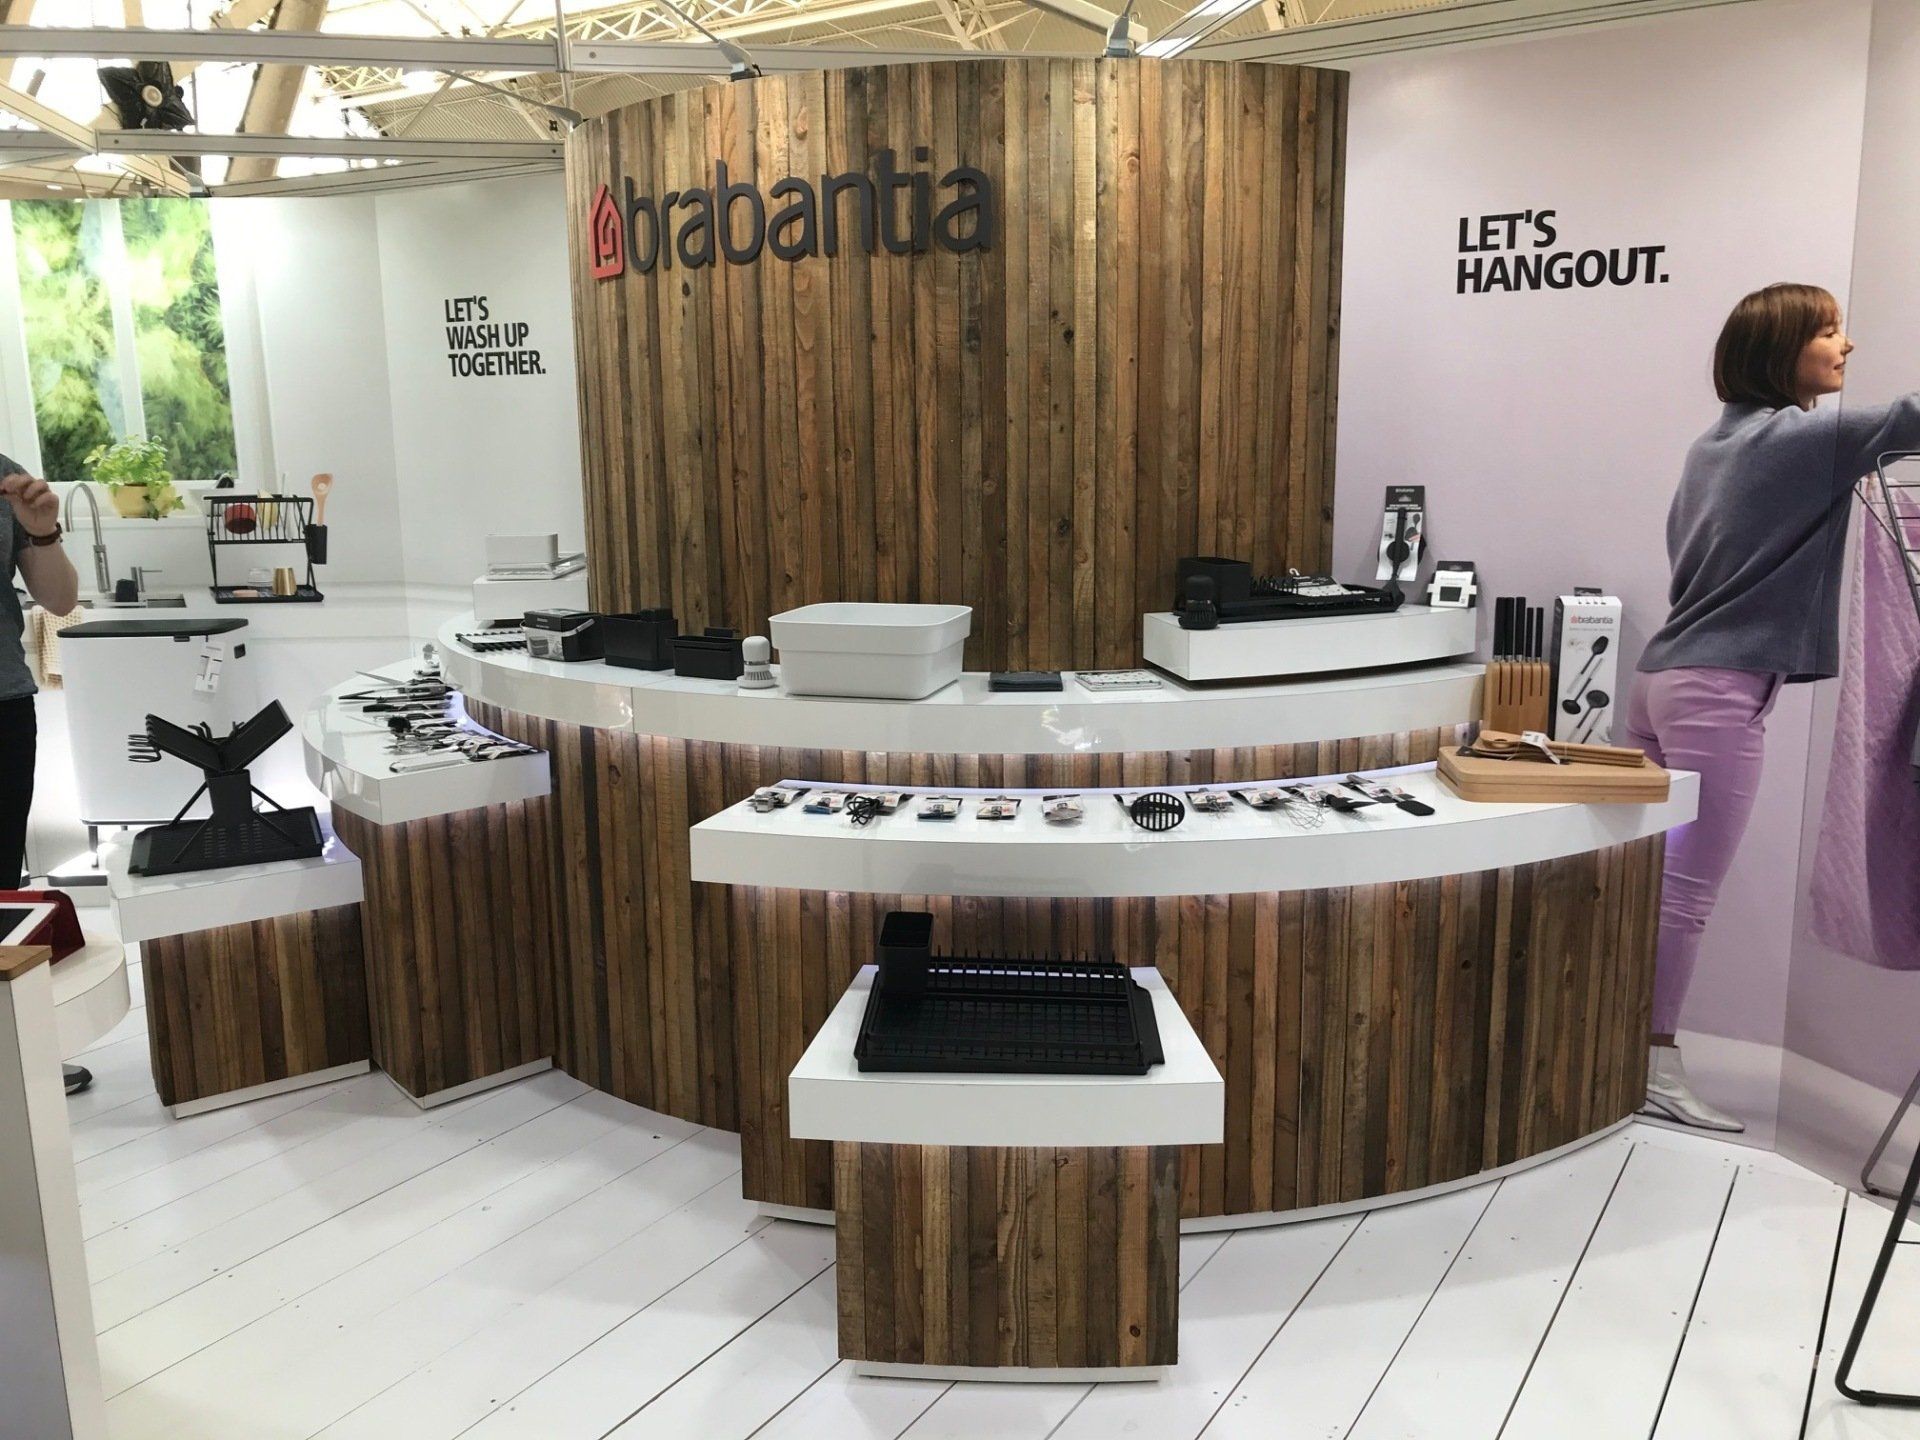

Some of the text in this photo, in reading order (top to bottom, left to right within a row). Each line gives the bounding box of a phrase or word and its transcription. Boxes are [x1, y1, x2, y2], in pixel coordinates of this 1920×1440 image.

[625, 146, 994, 274] brabantia
[1458, 209, 1557, 253] LET'S
[1457, 245, 1670, 294] HANGOUT.
[444, 295, 489, 323] LET'S
[446, 322, 529, 350] WASH UP
[447, 350, 547, 377] TOGETHER.
